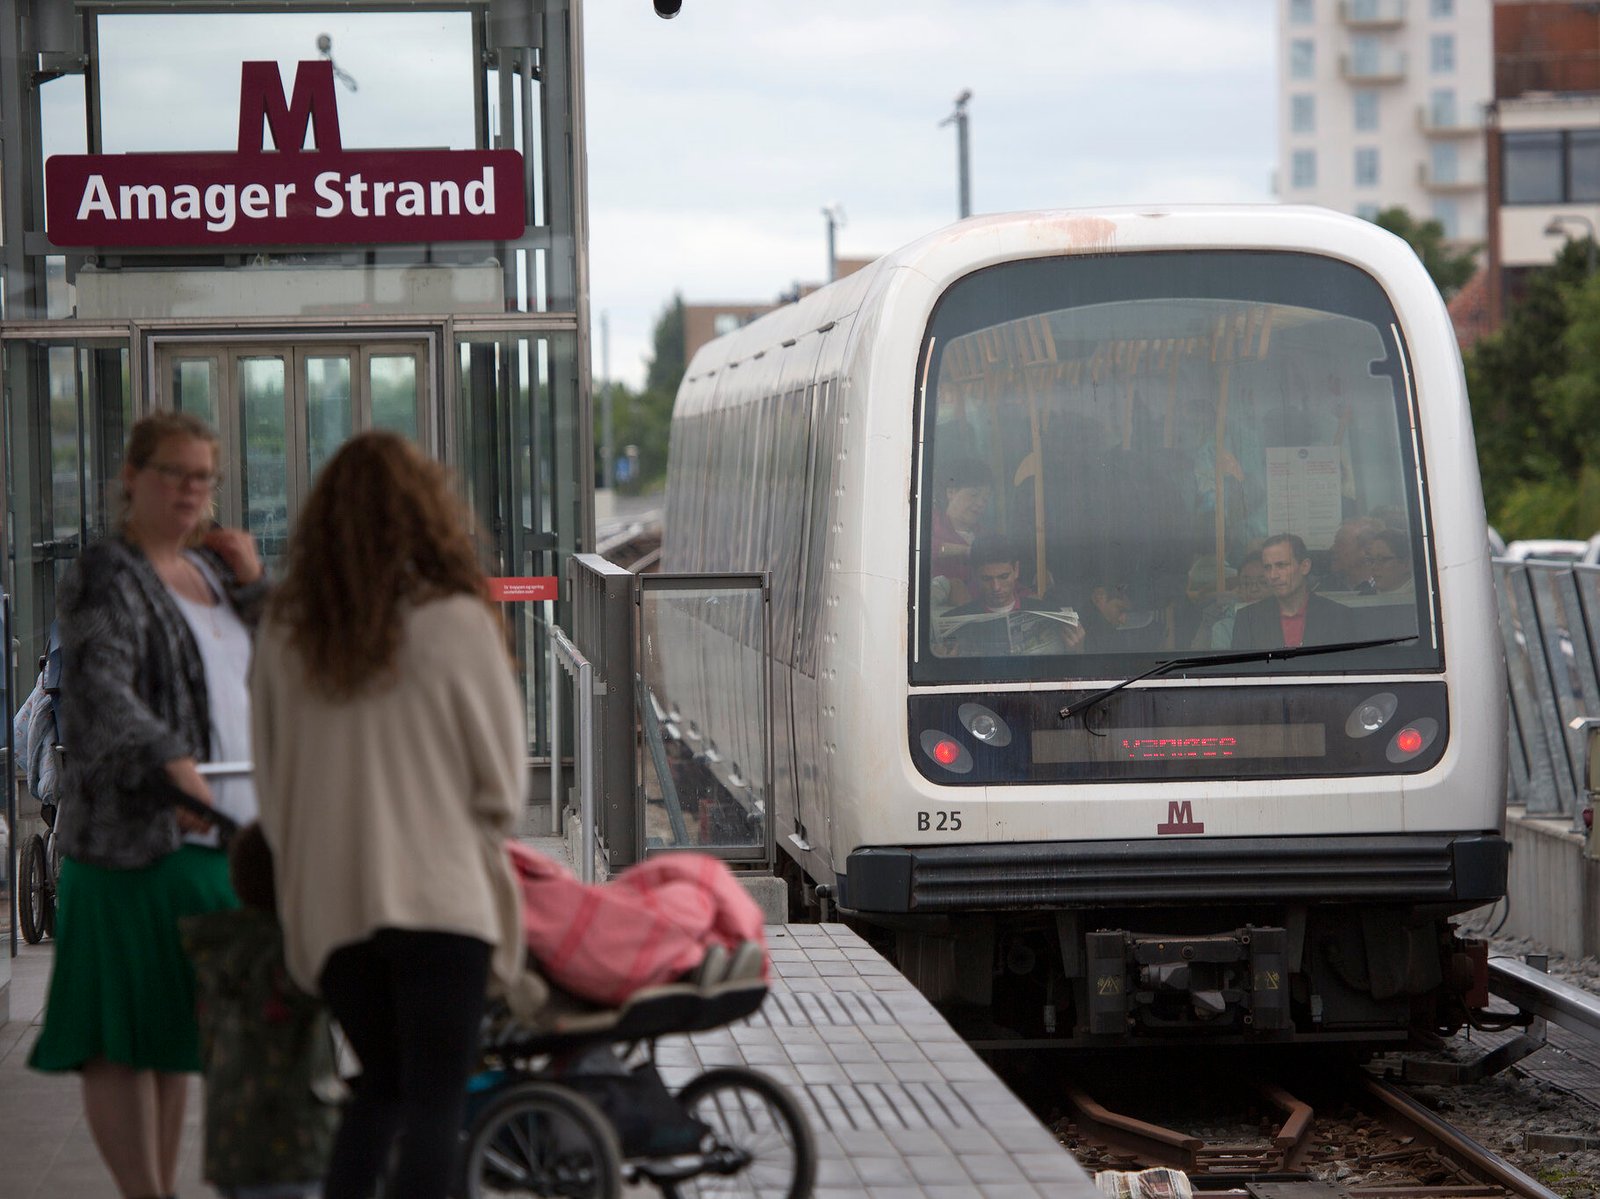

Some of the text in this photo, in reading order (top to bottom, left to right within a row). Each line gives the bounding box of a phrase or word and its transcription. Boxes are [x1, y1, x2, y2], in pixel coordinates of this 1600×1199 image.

[238, 61, 341, 152] M
[77, 166, 496, 232] Amager Strand
[917, 811, 962, 831] B 25
